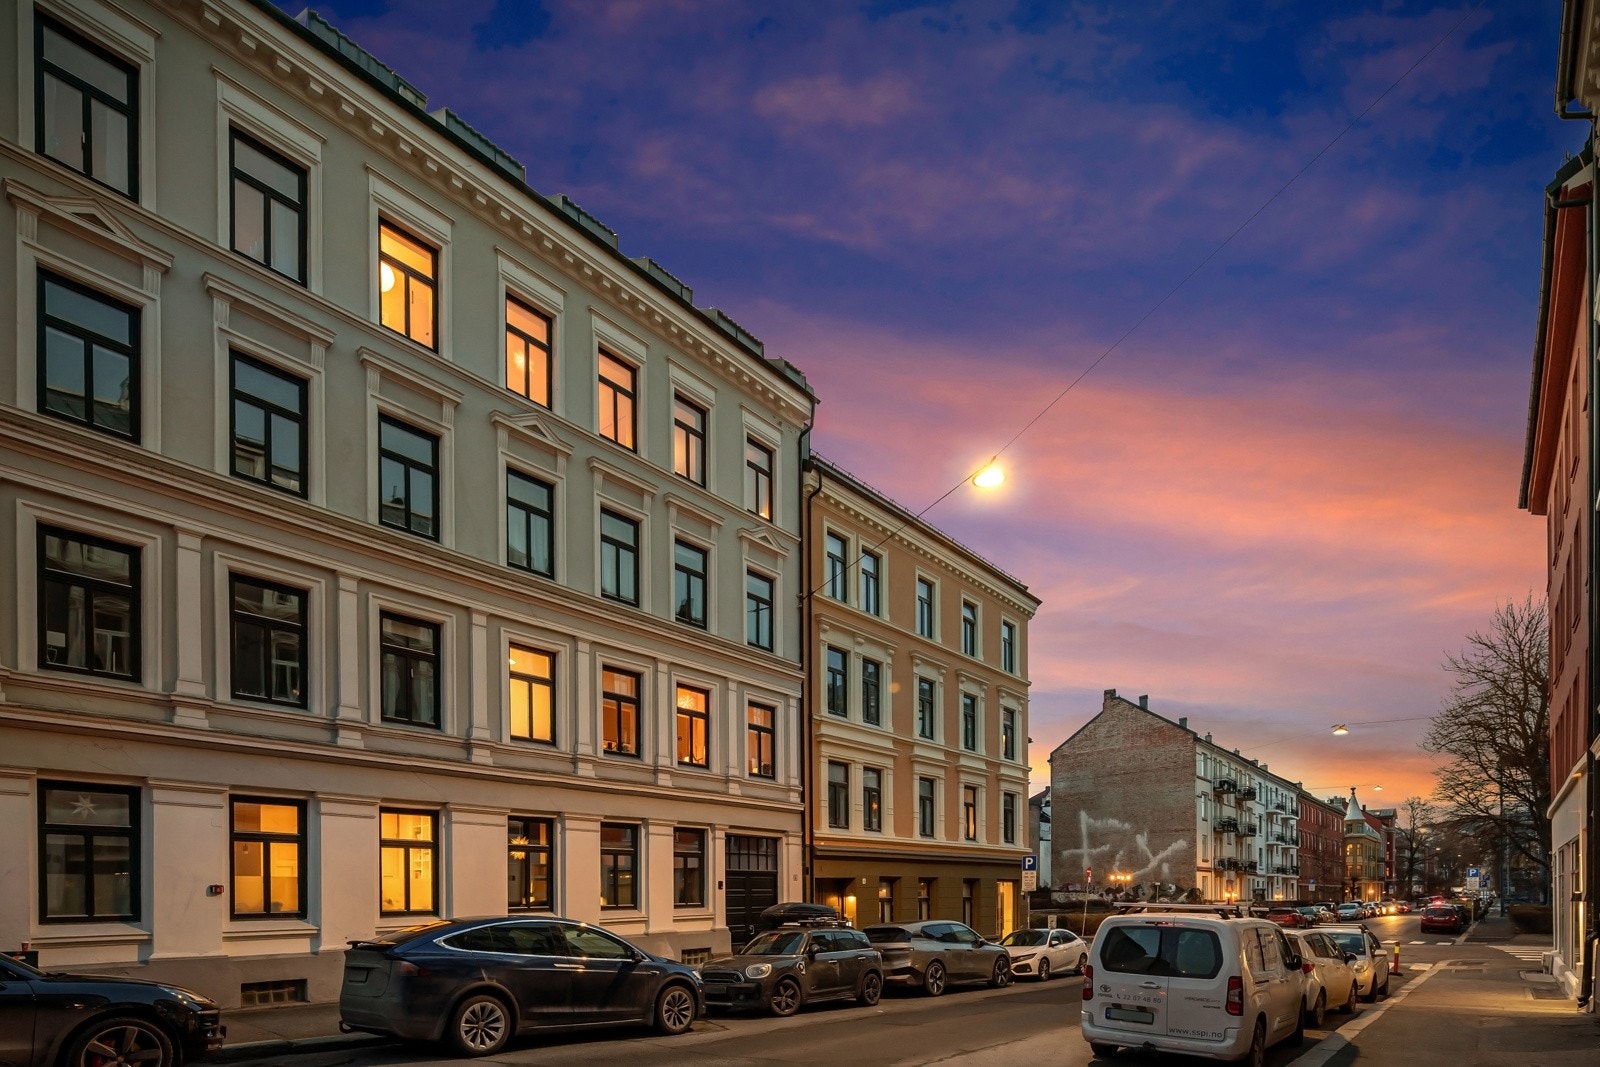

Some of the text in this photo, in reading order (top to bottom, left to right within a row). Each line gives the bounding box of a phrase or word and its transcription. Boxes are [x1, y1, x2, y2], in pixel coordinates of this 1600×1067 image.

[1025, 857, 1034, 870] P
[1469, 869, 1477, 877] P
[1168, 1027, 1223, 1038] www.sspi.no
